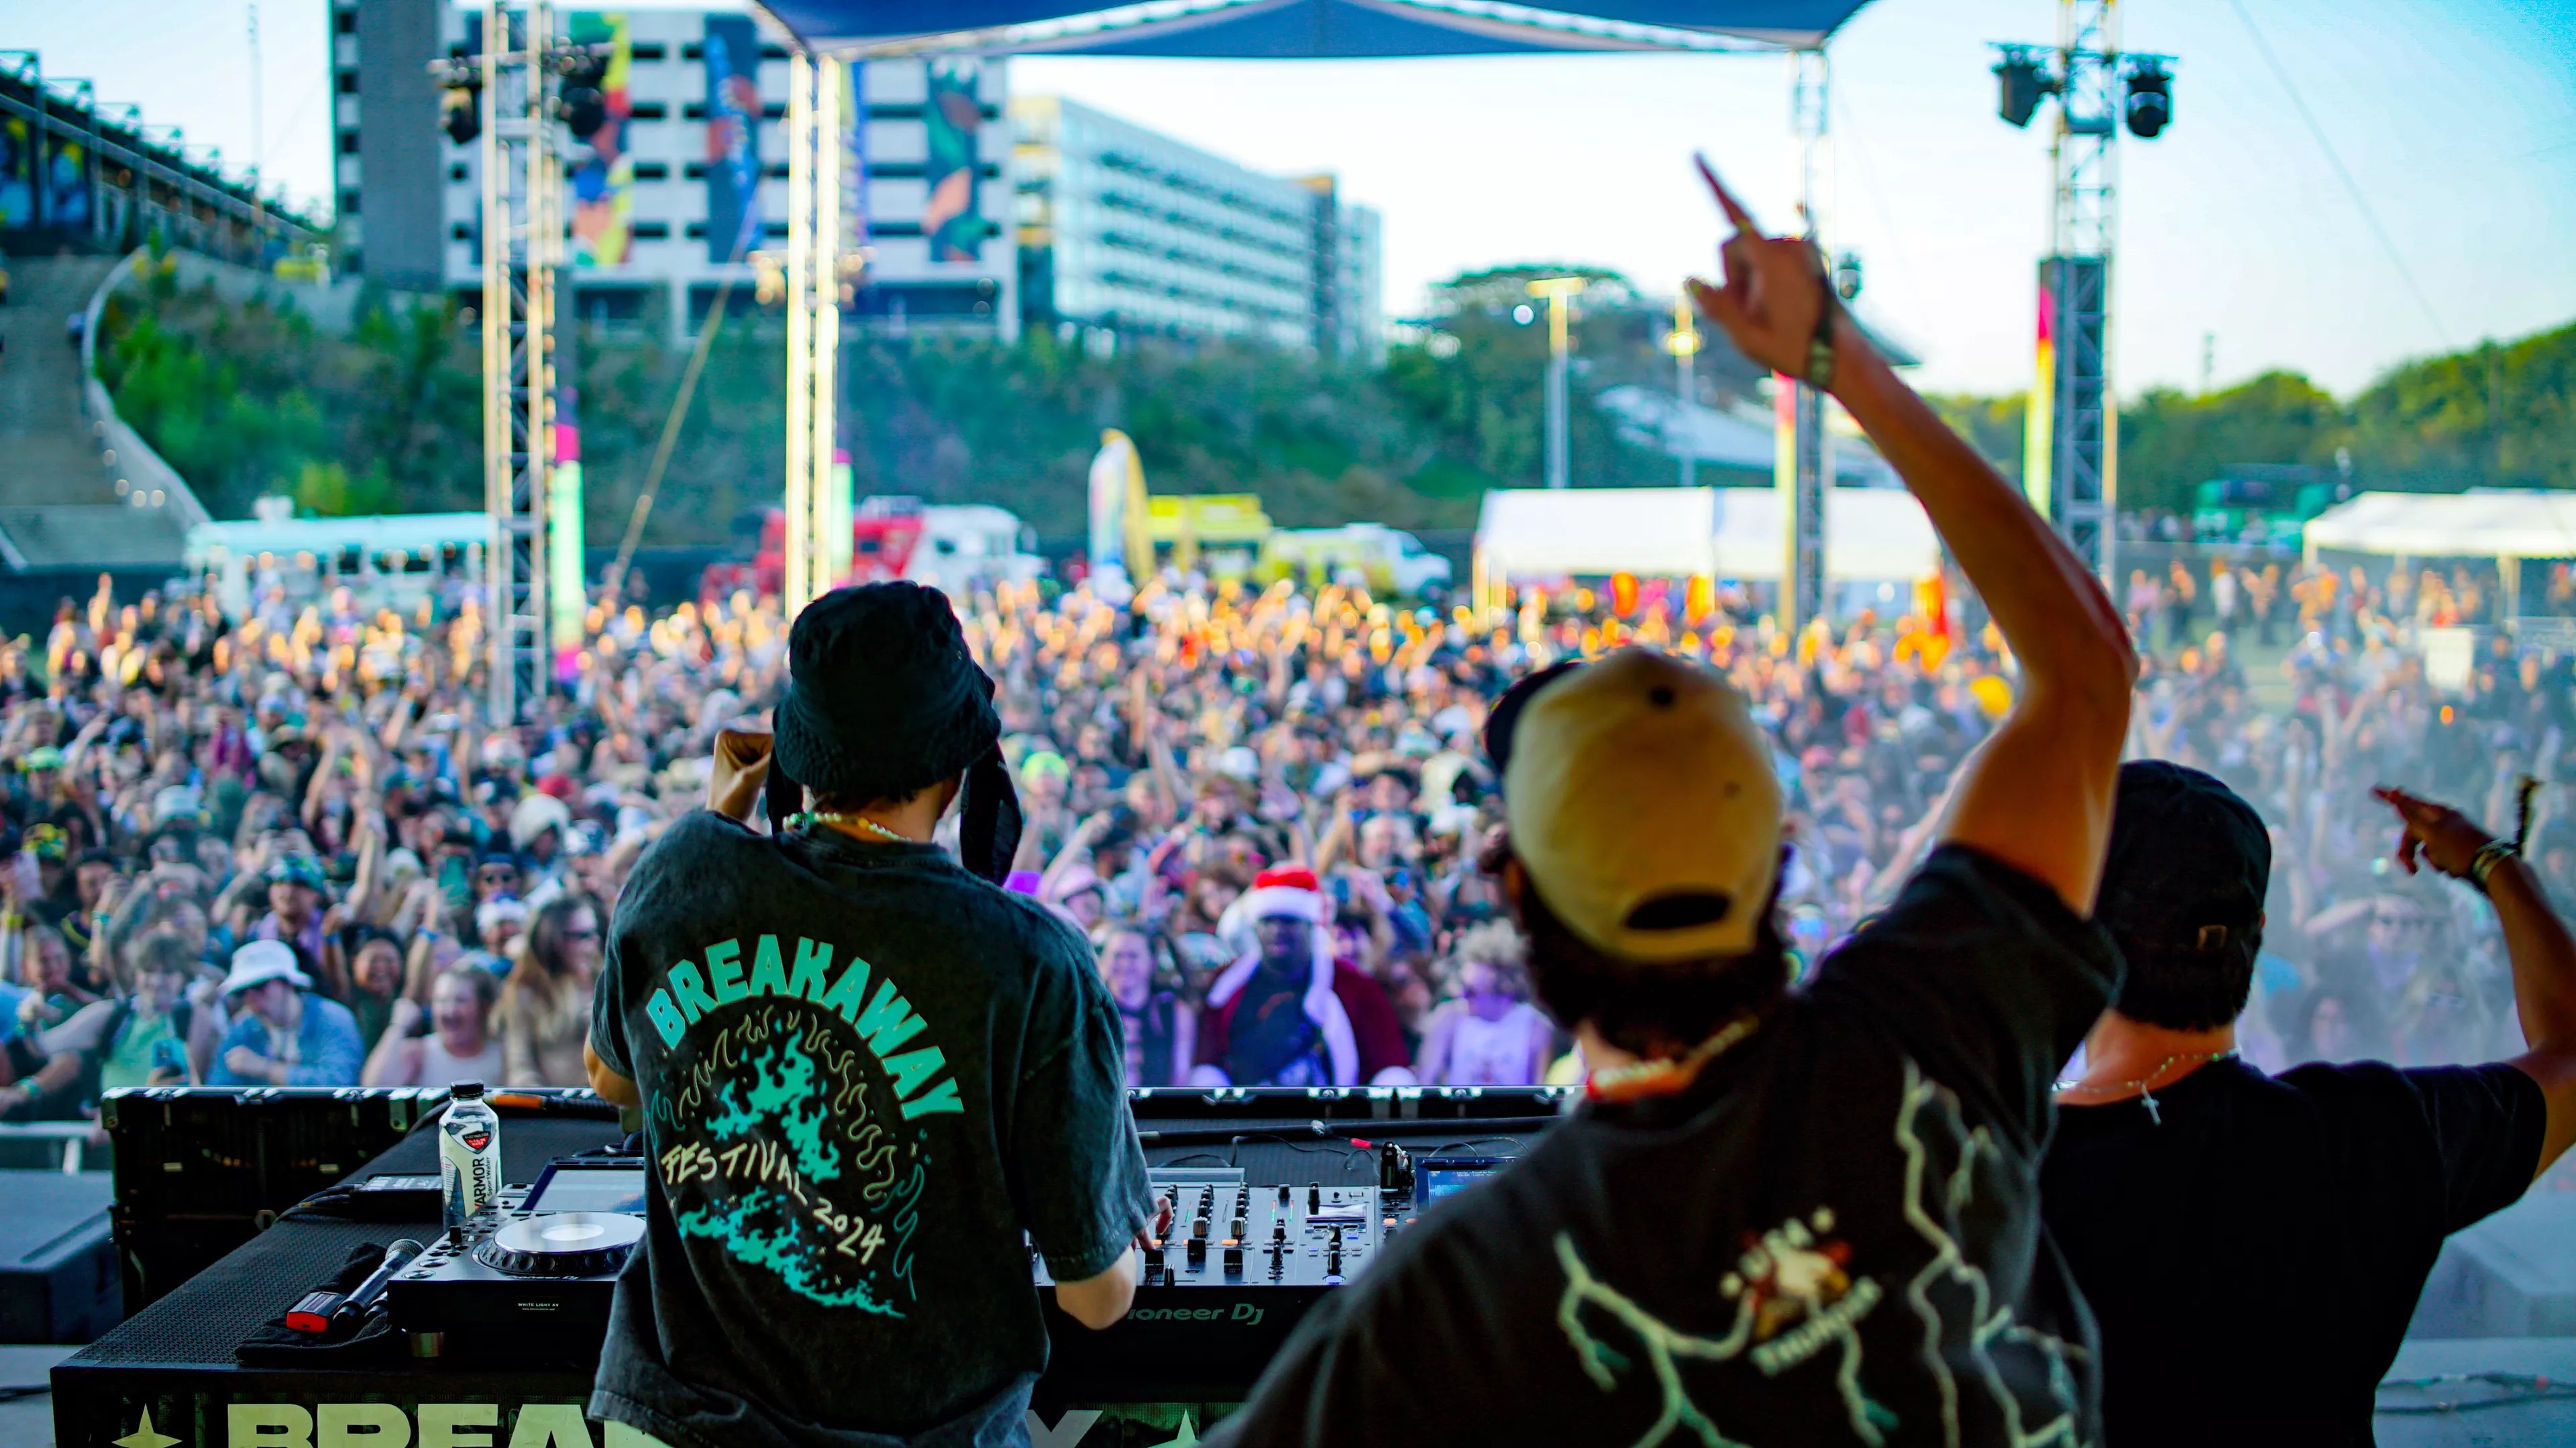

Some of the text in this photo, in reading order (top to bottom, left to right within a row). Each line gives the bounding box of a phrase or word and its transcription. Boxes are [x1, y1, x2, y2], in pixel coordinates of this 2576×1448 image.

[645, 934, 964, 1120] BREAKAWAY
[661, 1138, 886, 1265] FESTIVAL 2024
[1127, 1308, 1226, 1321] ioneer
